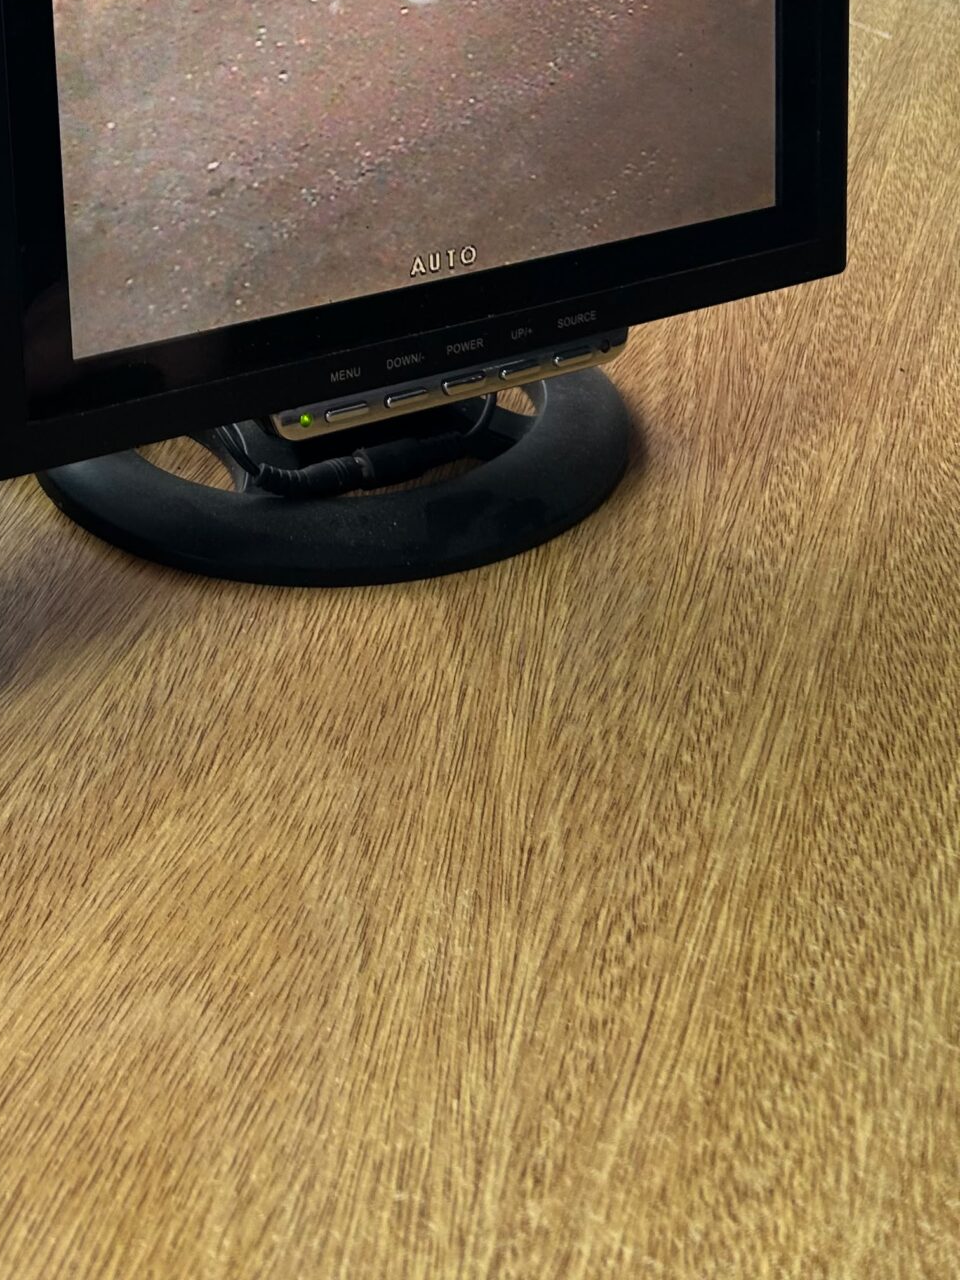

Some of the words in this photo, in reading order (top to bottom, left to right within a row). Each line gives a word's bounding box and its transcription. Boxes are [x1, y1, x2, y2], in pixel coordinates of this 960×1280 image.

[410, 245, 477, 277] AUTO
[557, 310, 597, 329] SOURCE
[511, 328, 532, 340] UP/+
[446, 337, 484, 355] POWER
[386, 352, 425, 370] DOWN/-
[330, 367, 361, 383] MENU
